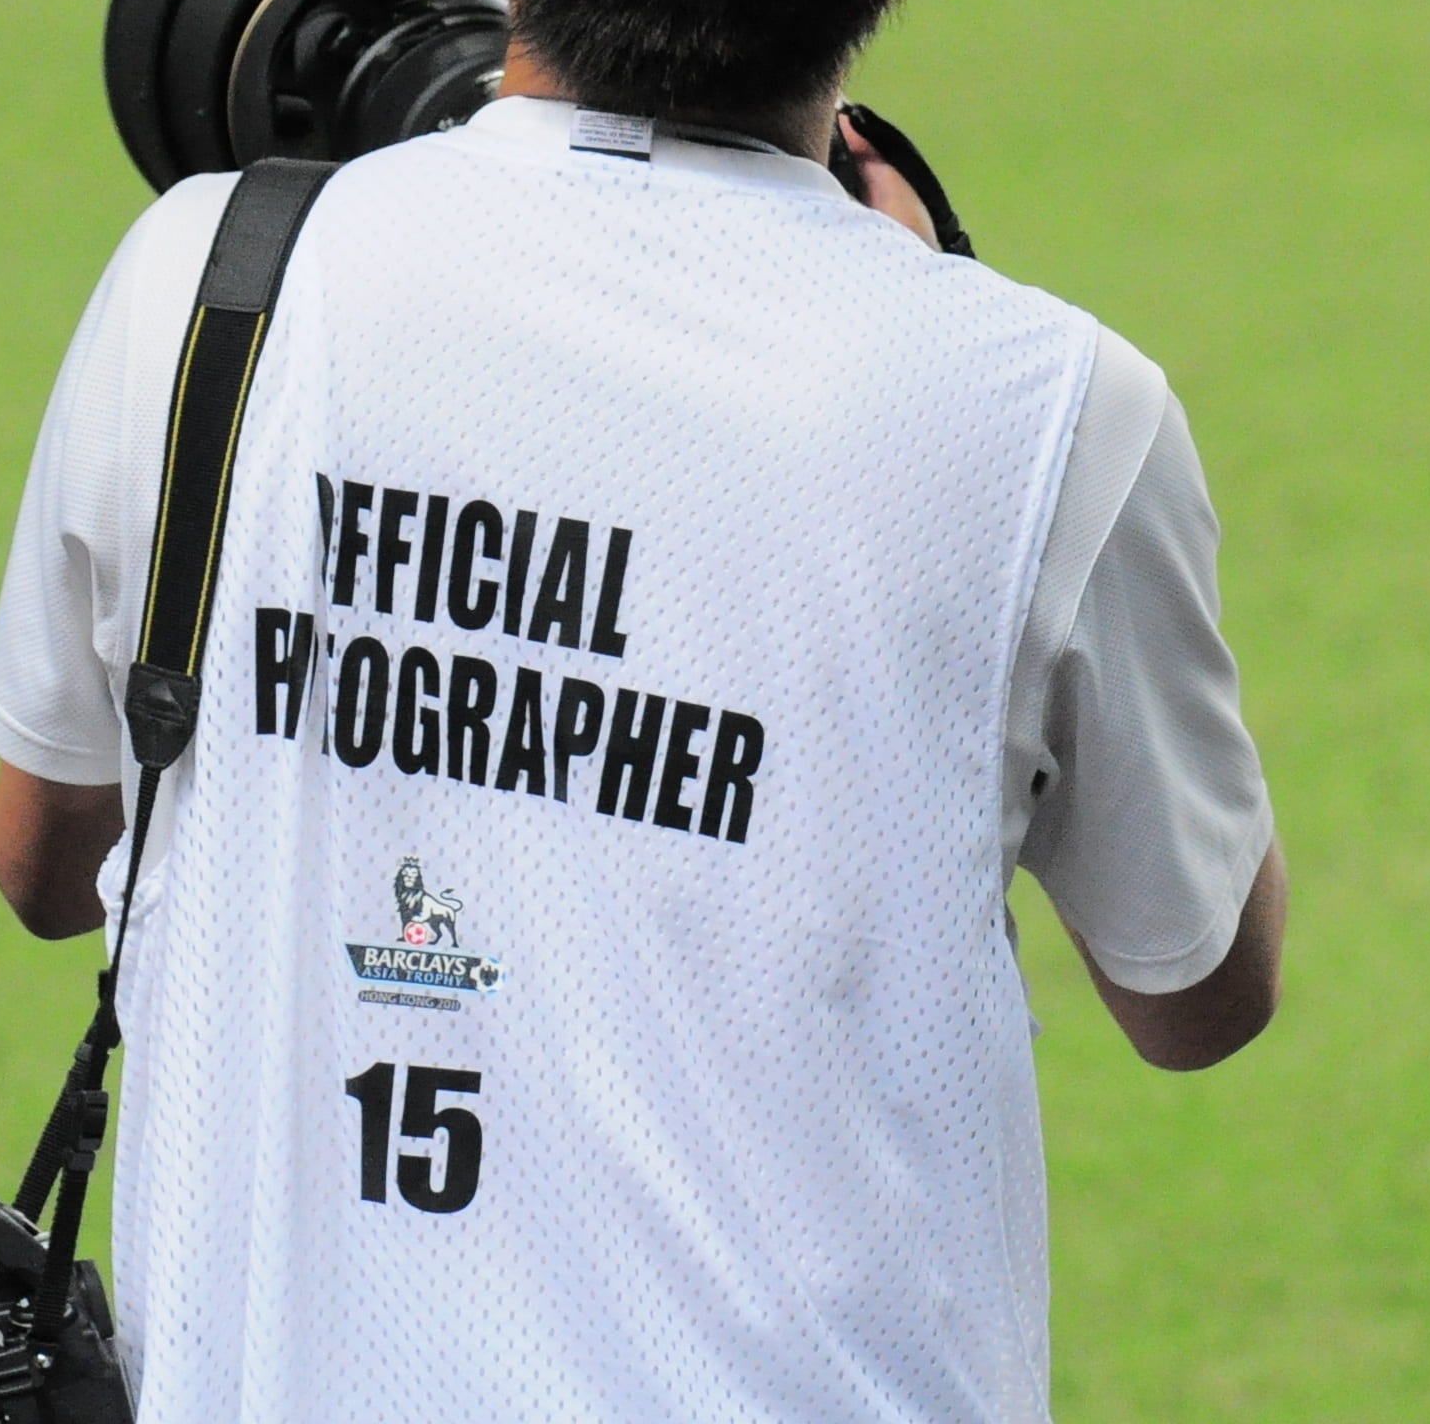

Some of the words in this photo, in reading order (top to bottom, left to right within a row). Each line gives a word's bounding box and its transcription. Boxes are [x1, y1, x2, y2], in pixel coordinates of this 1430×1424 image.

[363, 947, 468, 976] BARCLAYS
[361, 966, 399, 980] ASIA
[406, 970, 465, 987] TROPHY
[360, 991, 397, 1004] HONG
[399, 994, 436, 1007] KONG
[345, 1061, 483, 1214] 15
